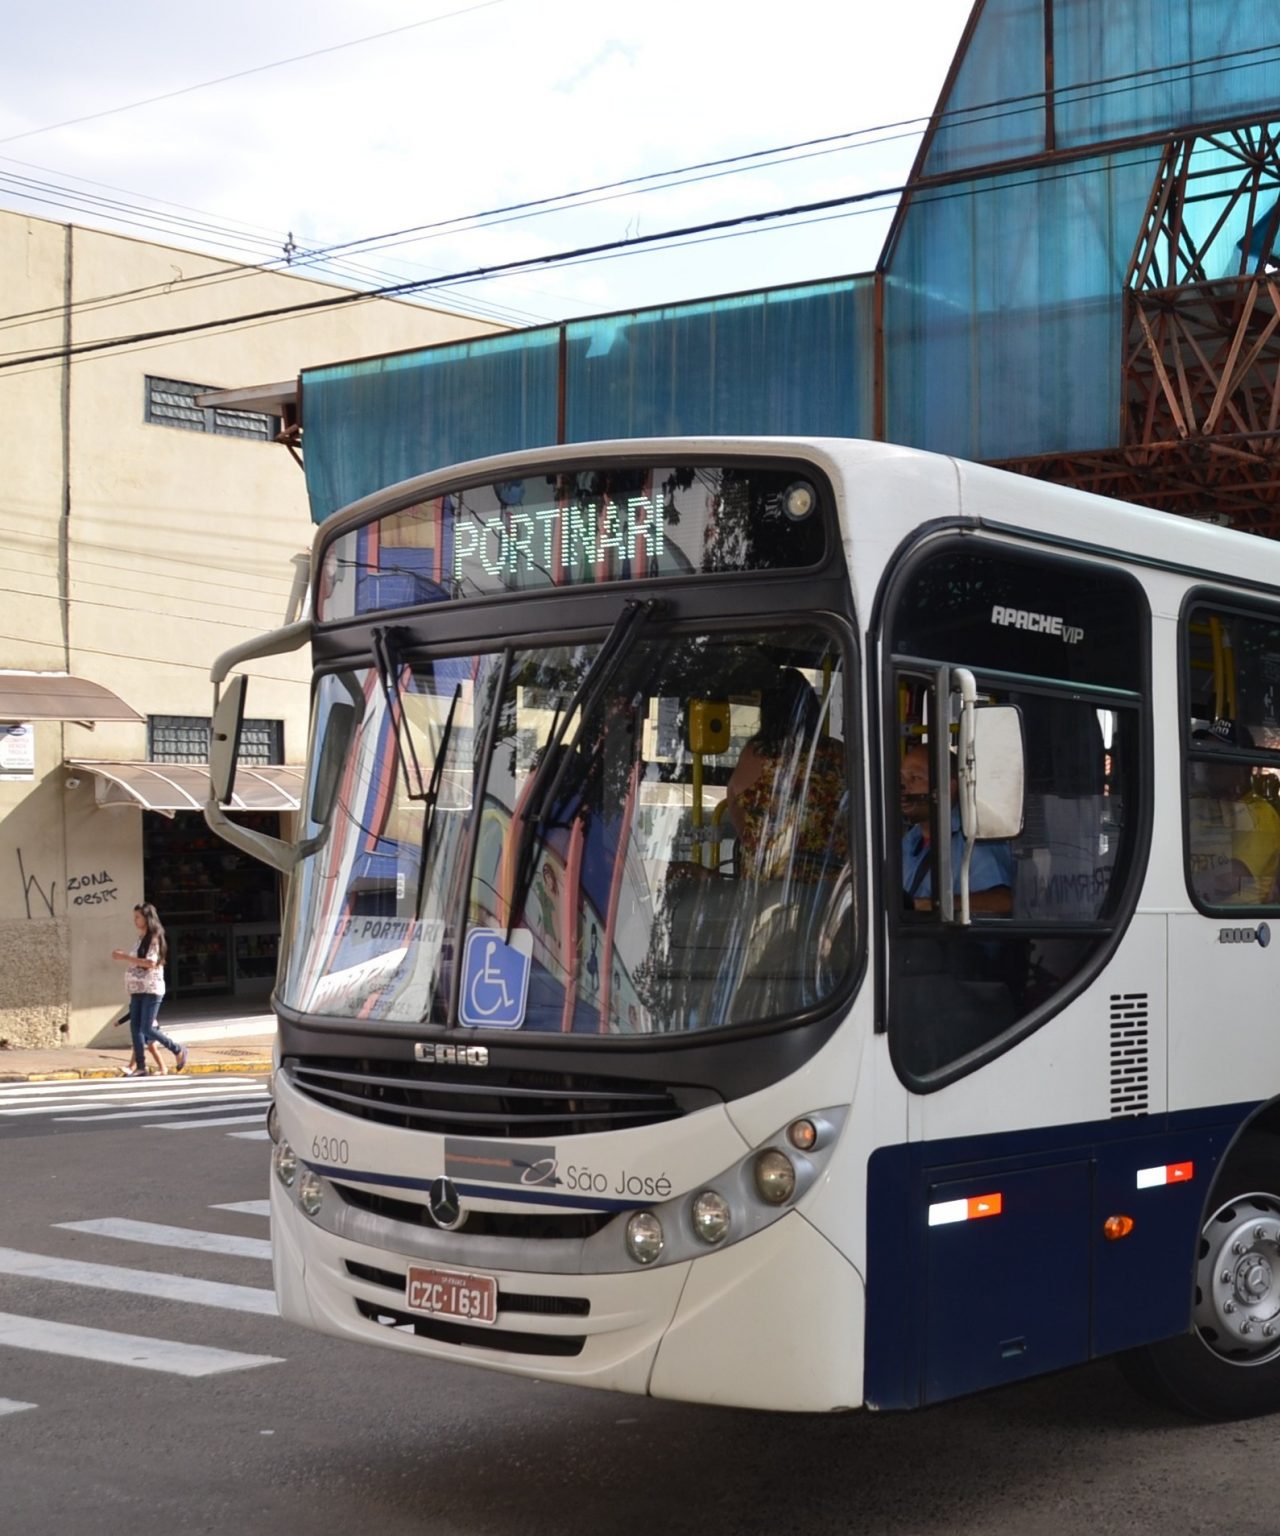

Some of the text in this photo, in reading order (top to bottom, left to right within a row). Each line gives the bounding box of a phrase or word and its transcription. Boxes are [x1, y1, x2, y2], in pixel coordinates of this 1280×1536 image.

[455, 494, 664, 580] PORTINARI
[991, 605, 1084, 644] APACHE VIP
[67, 870, 113, 891] ZONA
[414, 1043, 489, 1066] CAIO
[312, 1135, 349, 1164] 6300
[566, 1166, 672, 1197] São José
